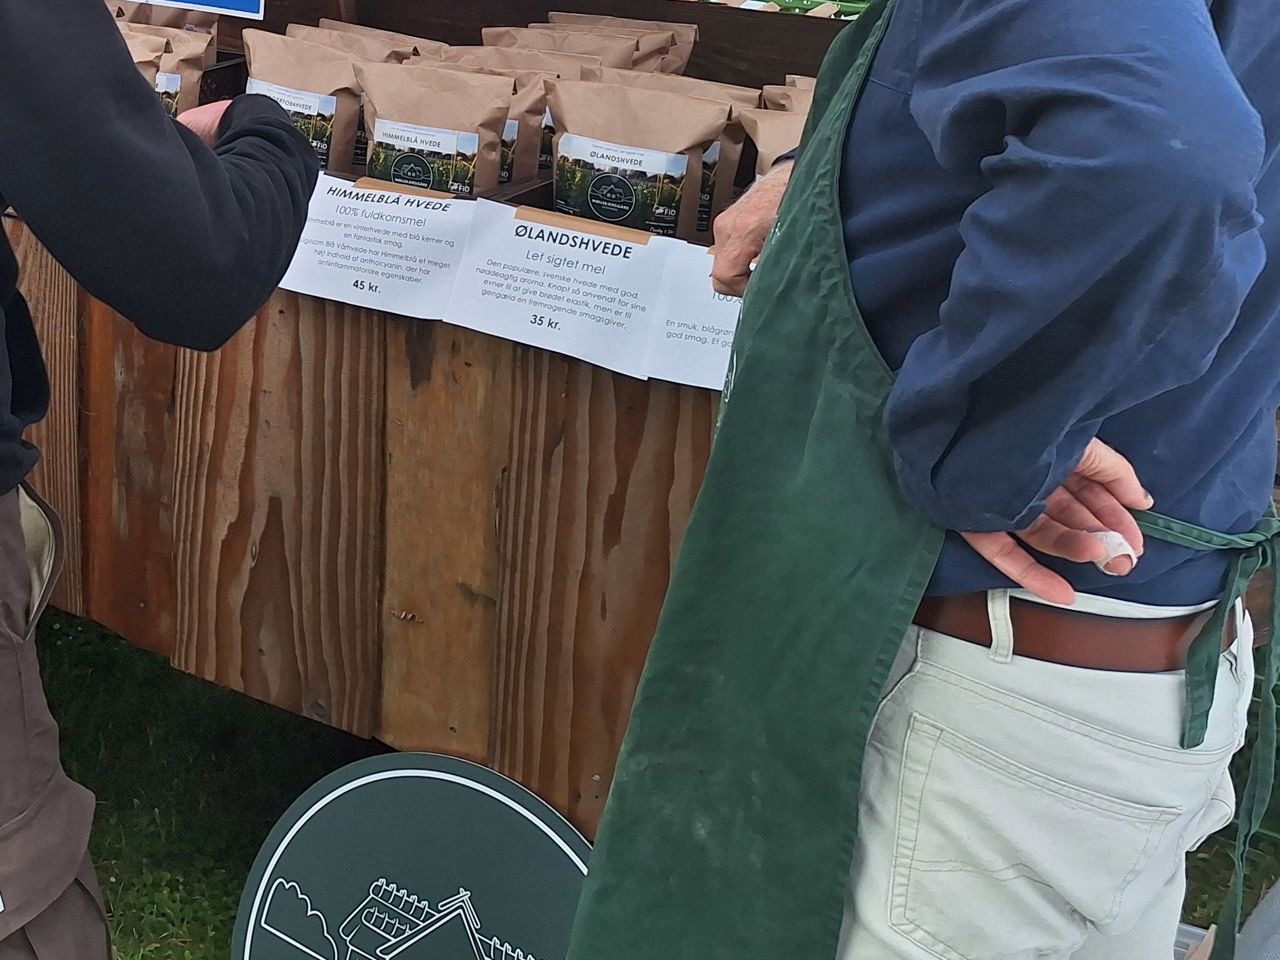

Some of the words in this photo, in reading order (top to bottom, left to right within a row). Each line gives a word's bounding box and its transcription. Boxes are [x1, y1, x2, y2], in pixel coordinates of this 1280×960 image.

[420, 138, 441, 148] HVEDE
[590, 151, 643, 166] ØLANDSHVEDE
[326, 186, 401, 205] HIMMELBLÅ
[404, 198, 452, 212] HVEDE
[335, 205, 359, 216] 100%
[361, 208, 427, 227] fuldkornsmel
[515, 225, 633, 259] ØLANDSHVEDE
[526, 250, 544, 261] Let
[546, 254, 579, 270] sigtet
[582, 263, 606, 275] mel
[352, 280, 365, 290] 45
[368, 282, 381, 294] kr.
[487, 259, 502, 268] Den
[543, 272, 571, 283] svenske
[573, 278, 597, 289] hvede
[600, 284, 619, 294] med
[476, 266, 518, 282] nøddeagtig
[547, 282, 570, 294] Knapt
[572, 286, 581, 295] så
[582, 291, 616, 304] anvendt
[618, 298, 629, 307] for
[630, 302, 647, 312] sine
[484, 279, 504, 289] evner
[522, 287, 538, 297] give
[539, 289, 565, 302] brødet
[593, 304, 612, 314] men
[530, 315, 544, 325] 35
[547, 318, 561, 331] kr.
[666, 331, 683, 339] god
[684, 334, 709, 344] smag.
